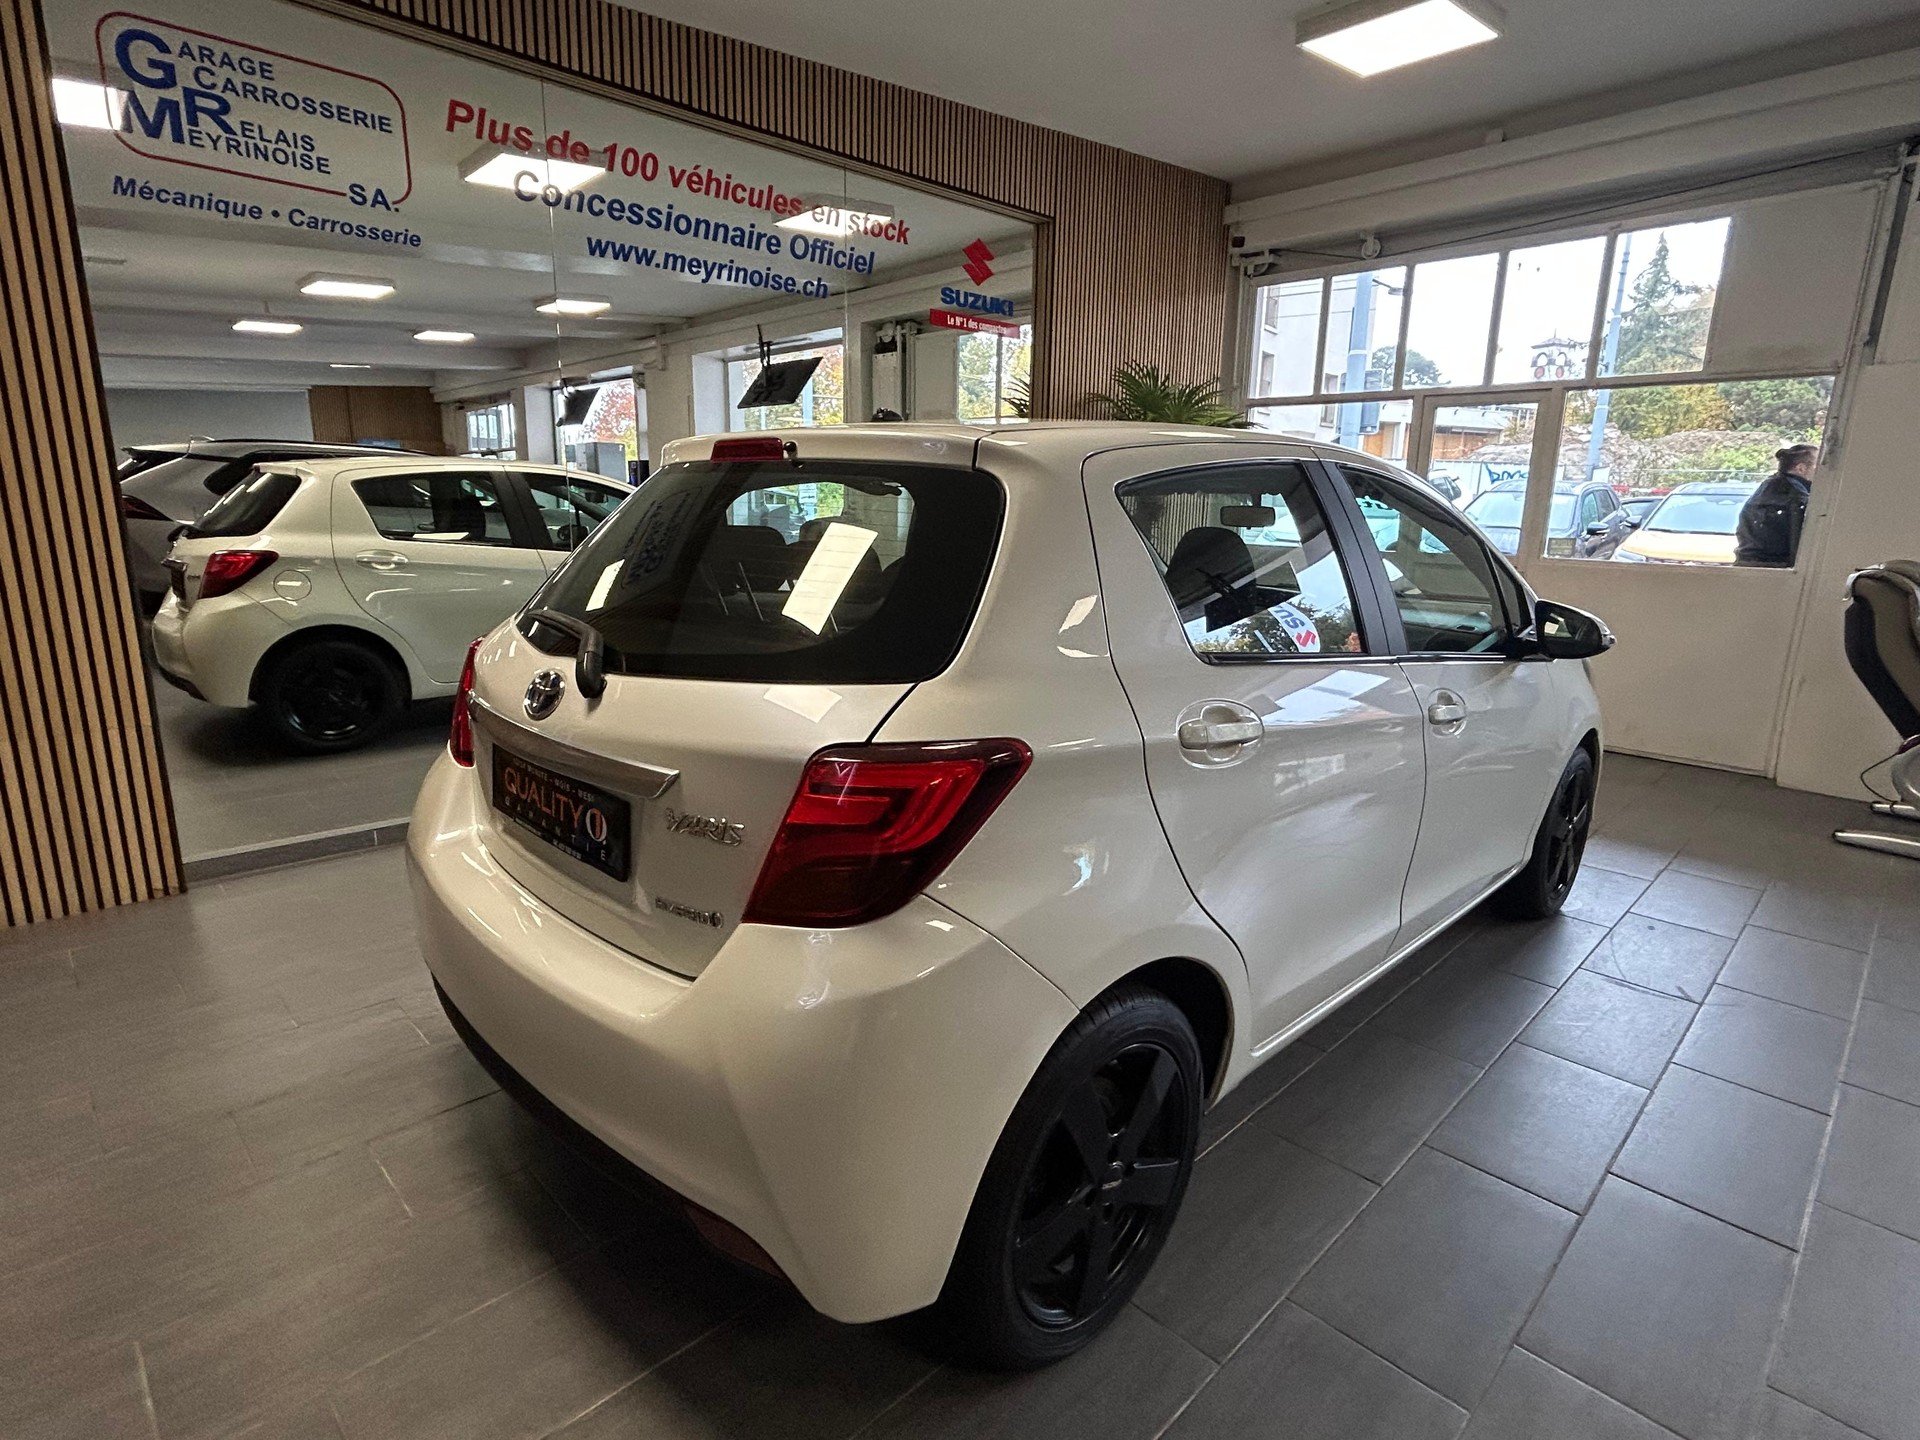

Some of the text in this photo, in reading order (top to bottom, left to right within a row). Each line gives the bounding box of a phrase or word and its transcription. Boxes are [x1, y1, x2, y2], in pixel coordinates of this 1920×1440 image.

[193, 66, 392, 134] CARROSSERIE
[348, 183, 400, 213] SA.
[445, 99, 910, 245] Plus de 100 véhicules en stock
[112, 175, 422, 248] Mécanique Carrosserie
[513, 170, 875, 274] Concessionnaire Officiel
[587, 236, 829, 298] www.meyrinoise.ch
[940, 286, 1014, 317] SUZUKI
[947, 314, 955, 326] Le
[968, 318, 978, 329] des
